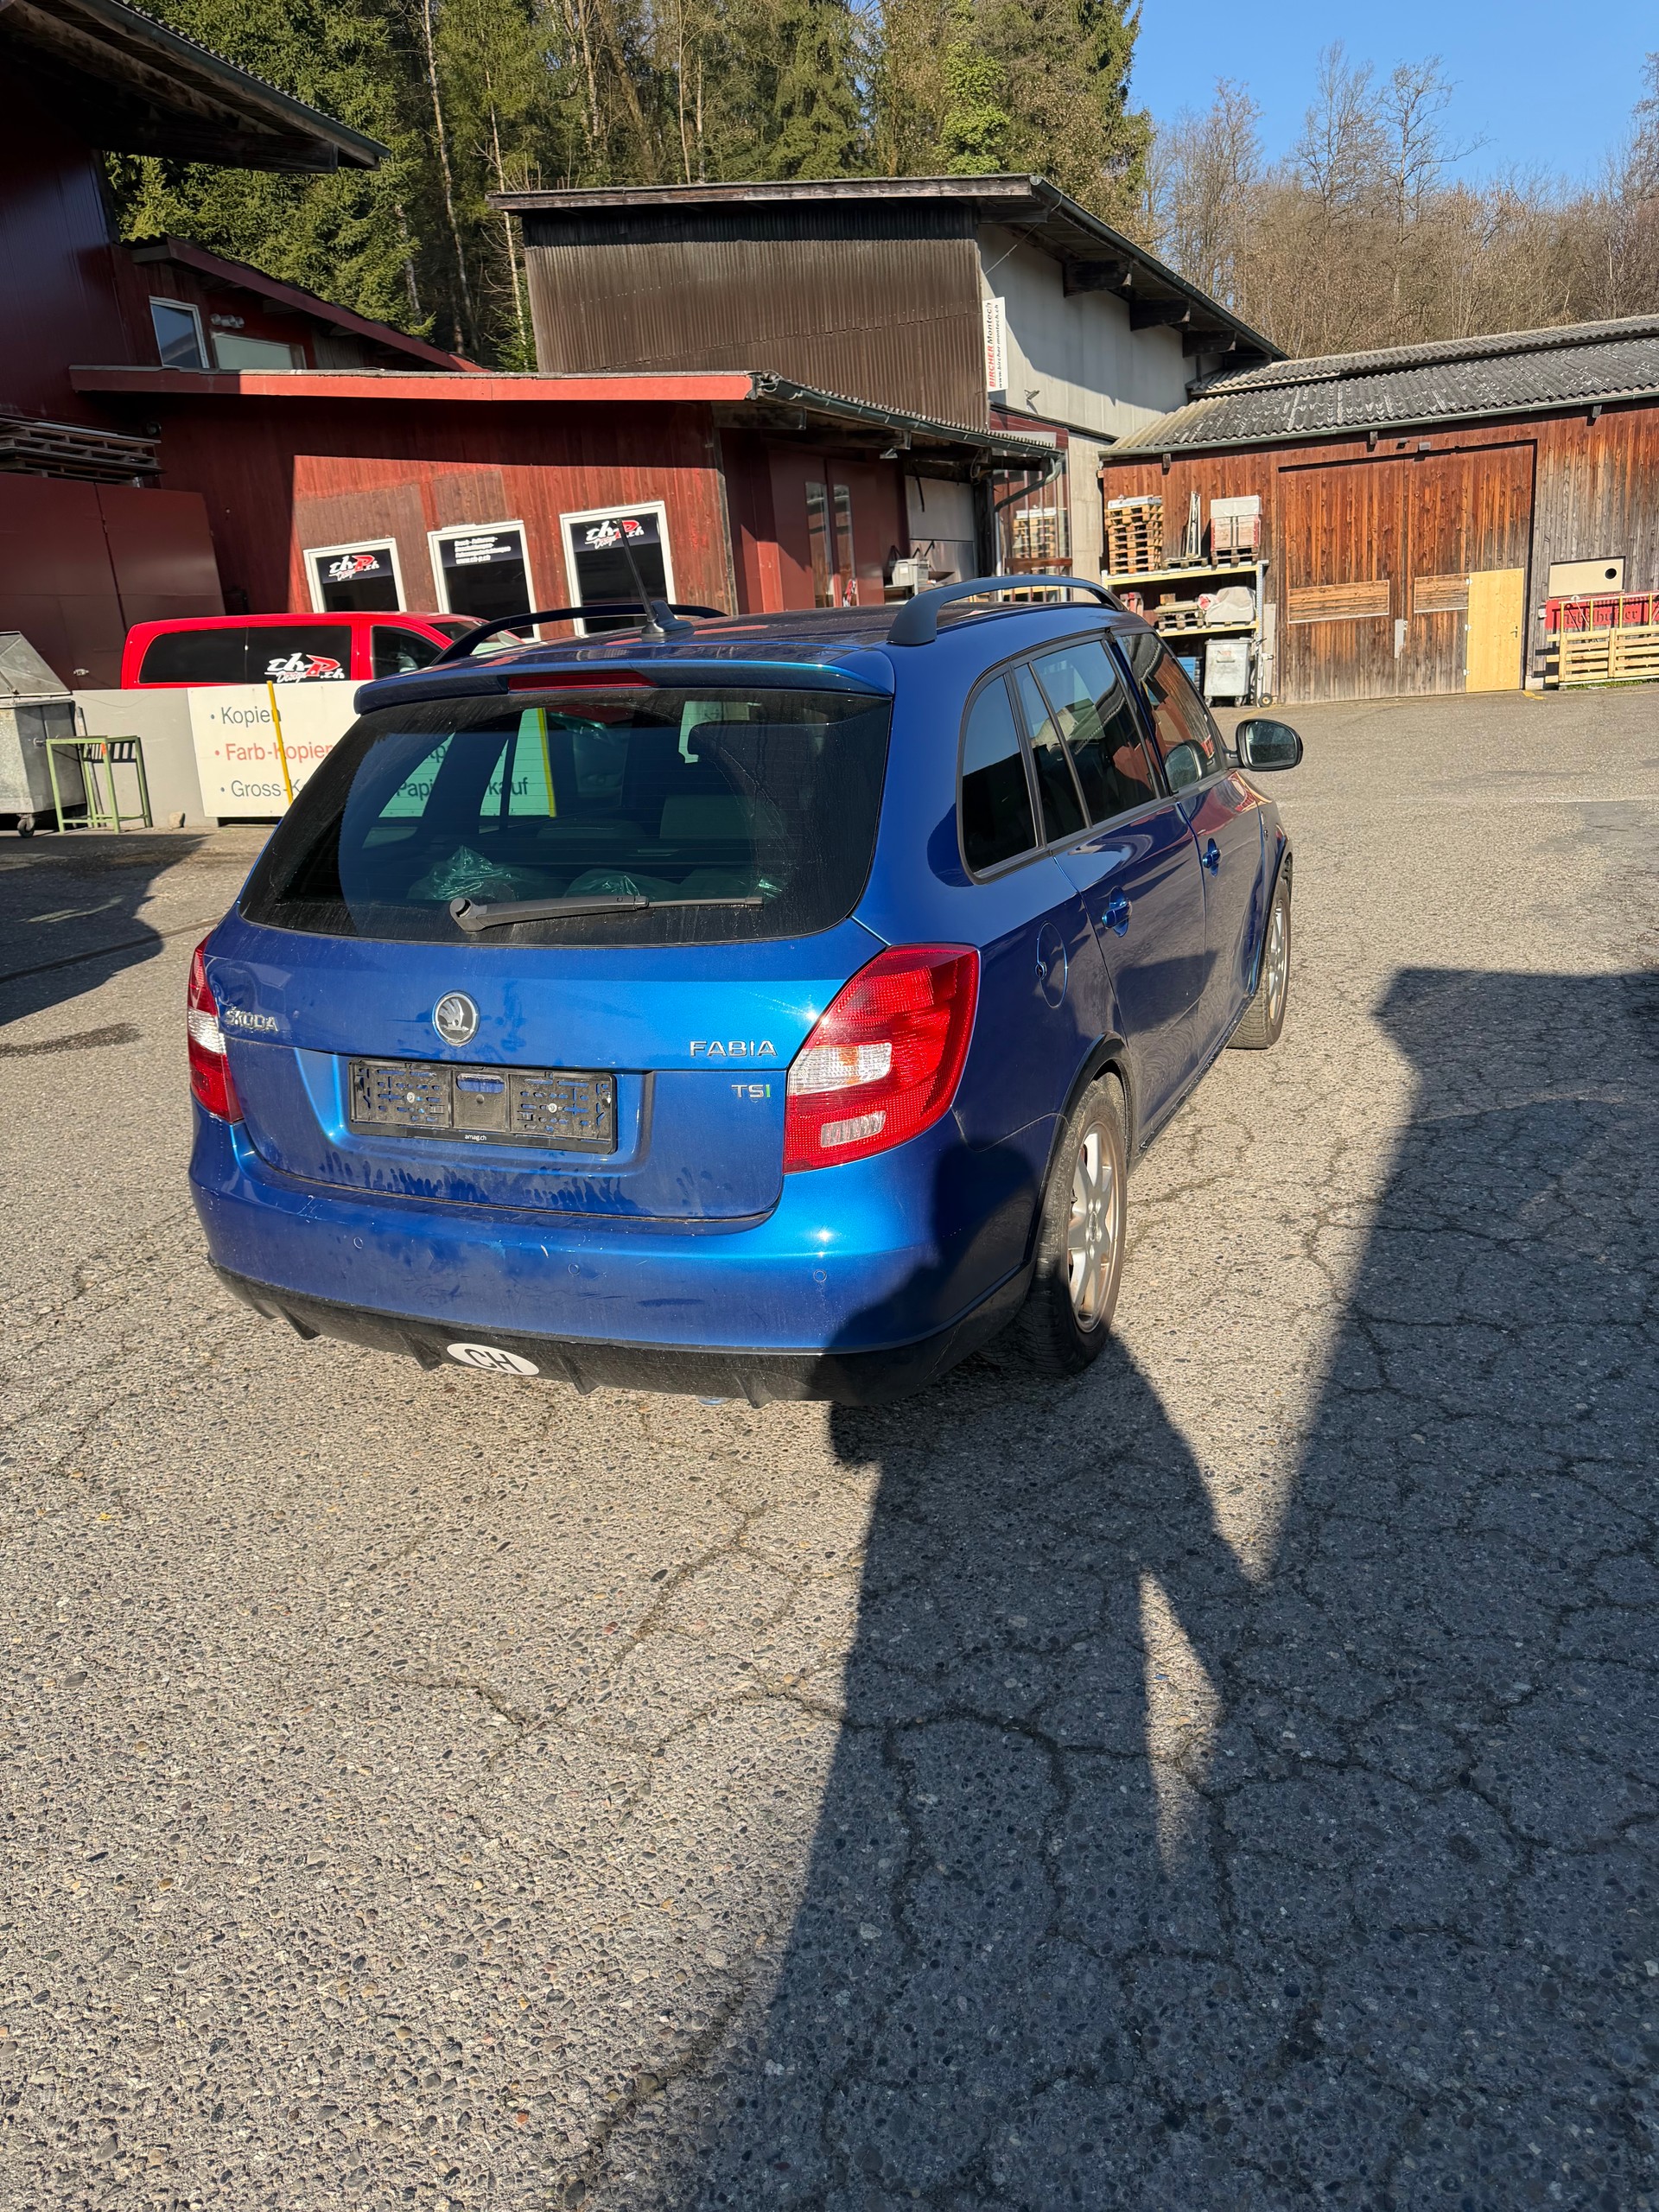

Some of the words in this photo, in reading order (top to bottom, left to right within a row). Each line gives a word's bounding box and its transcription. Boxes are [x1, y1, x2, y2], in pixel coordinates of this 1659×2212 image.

[985, 302, 994, 344] Montech
[987, 346, 996, 388] BIRCHER
[220, 705, 282, 728] Kopien
[231, 779, 302, 798] Gross-K
[690, 1040, 778, 1057] FABIA
[731, 1084, 771, 1098] TSI
[464, 1348, 524, 1374] CH
